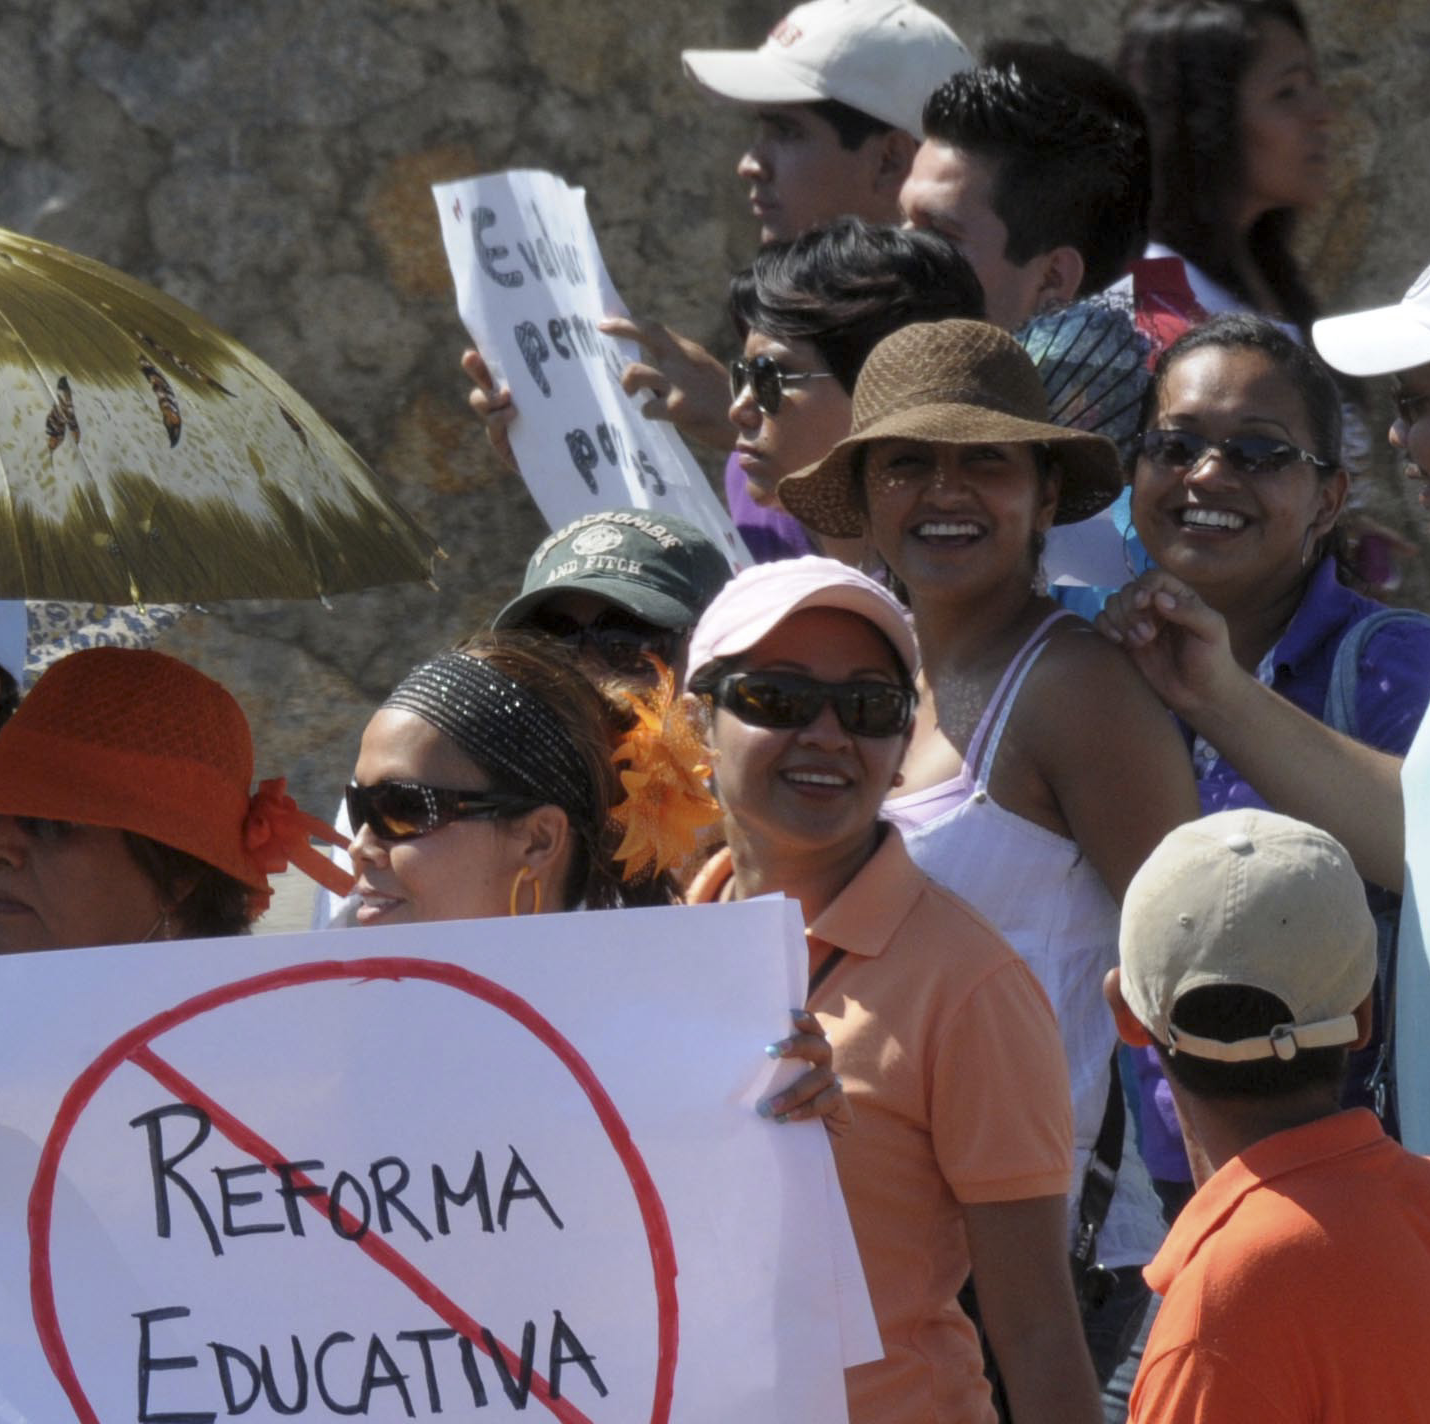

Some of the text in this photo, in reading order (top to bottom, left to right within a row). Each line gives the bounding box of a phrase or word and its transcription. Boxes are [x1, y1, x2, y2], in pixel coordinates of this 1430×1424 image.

[546, 554, 644, 584] AND FITCH
[130, 1103, 563, 1256] REFORMA
[133, 1307, 607, 1424] EDUCATIVA
